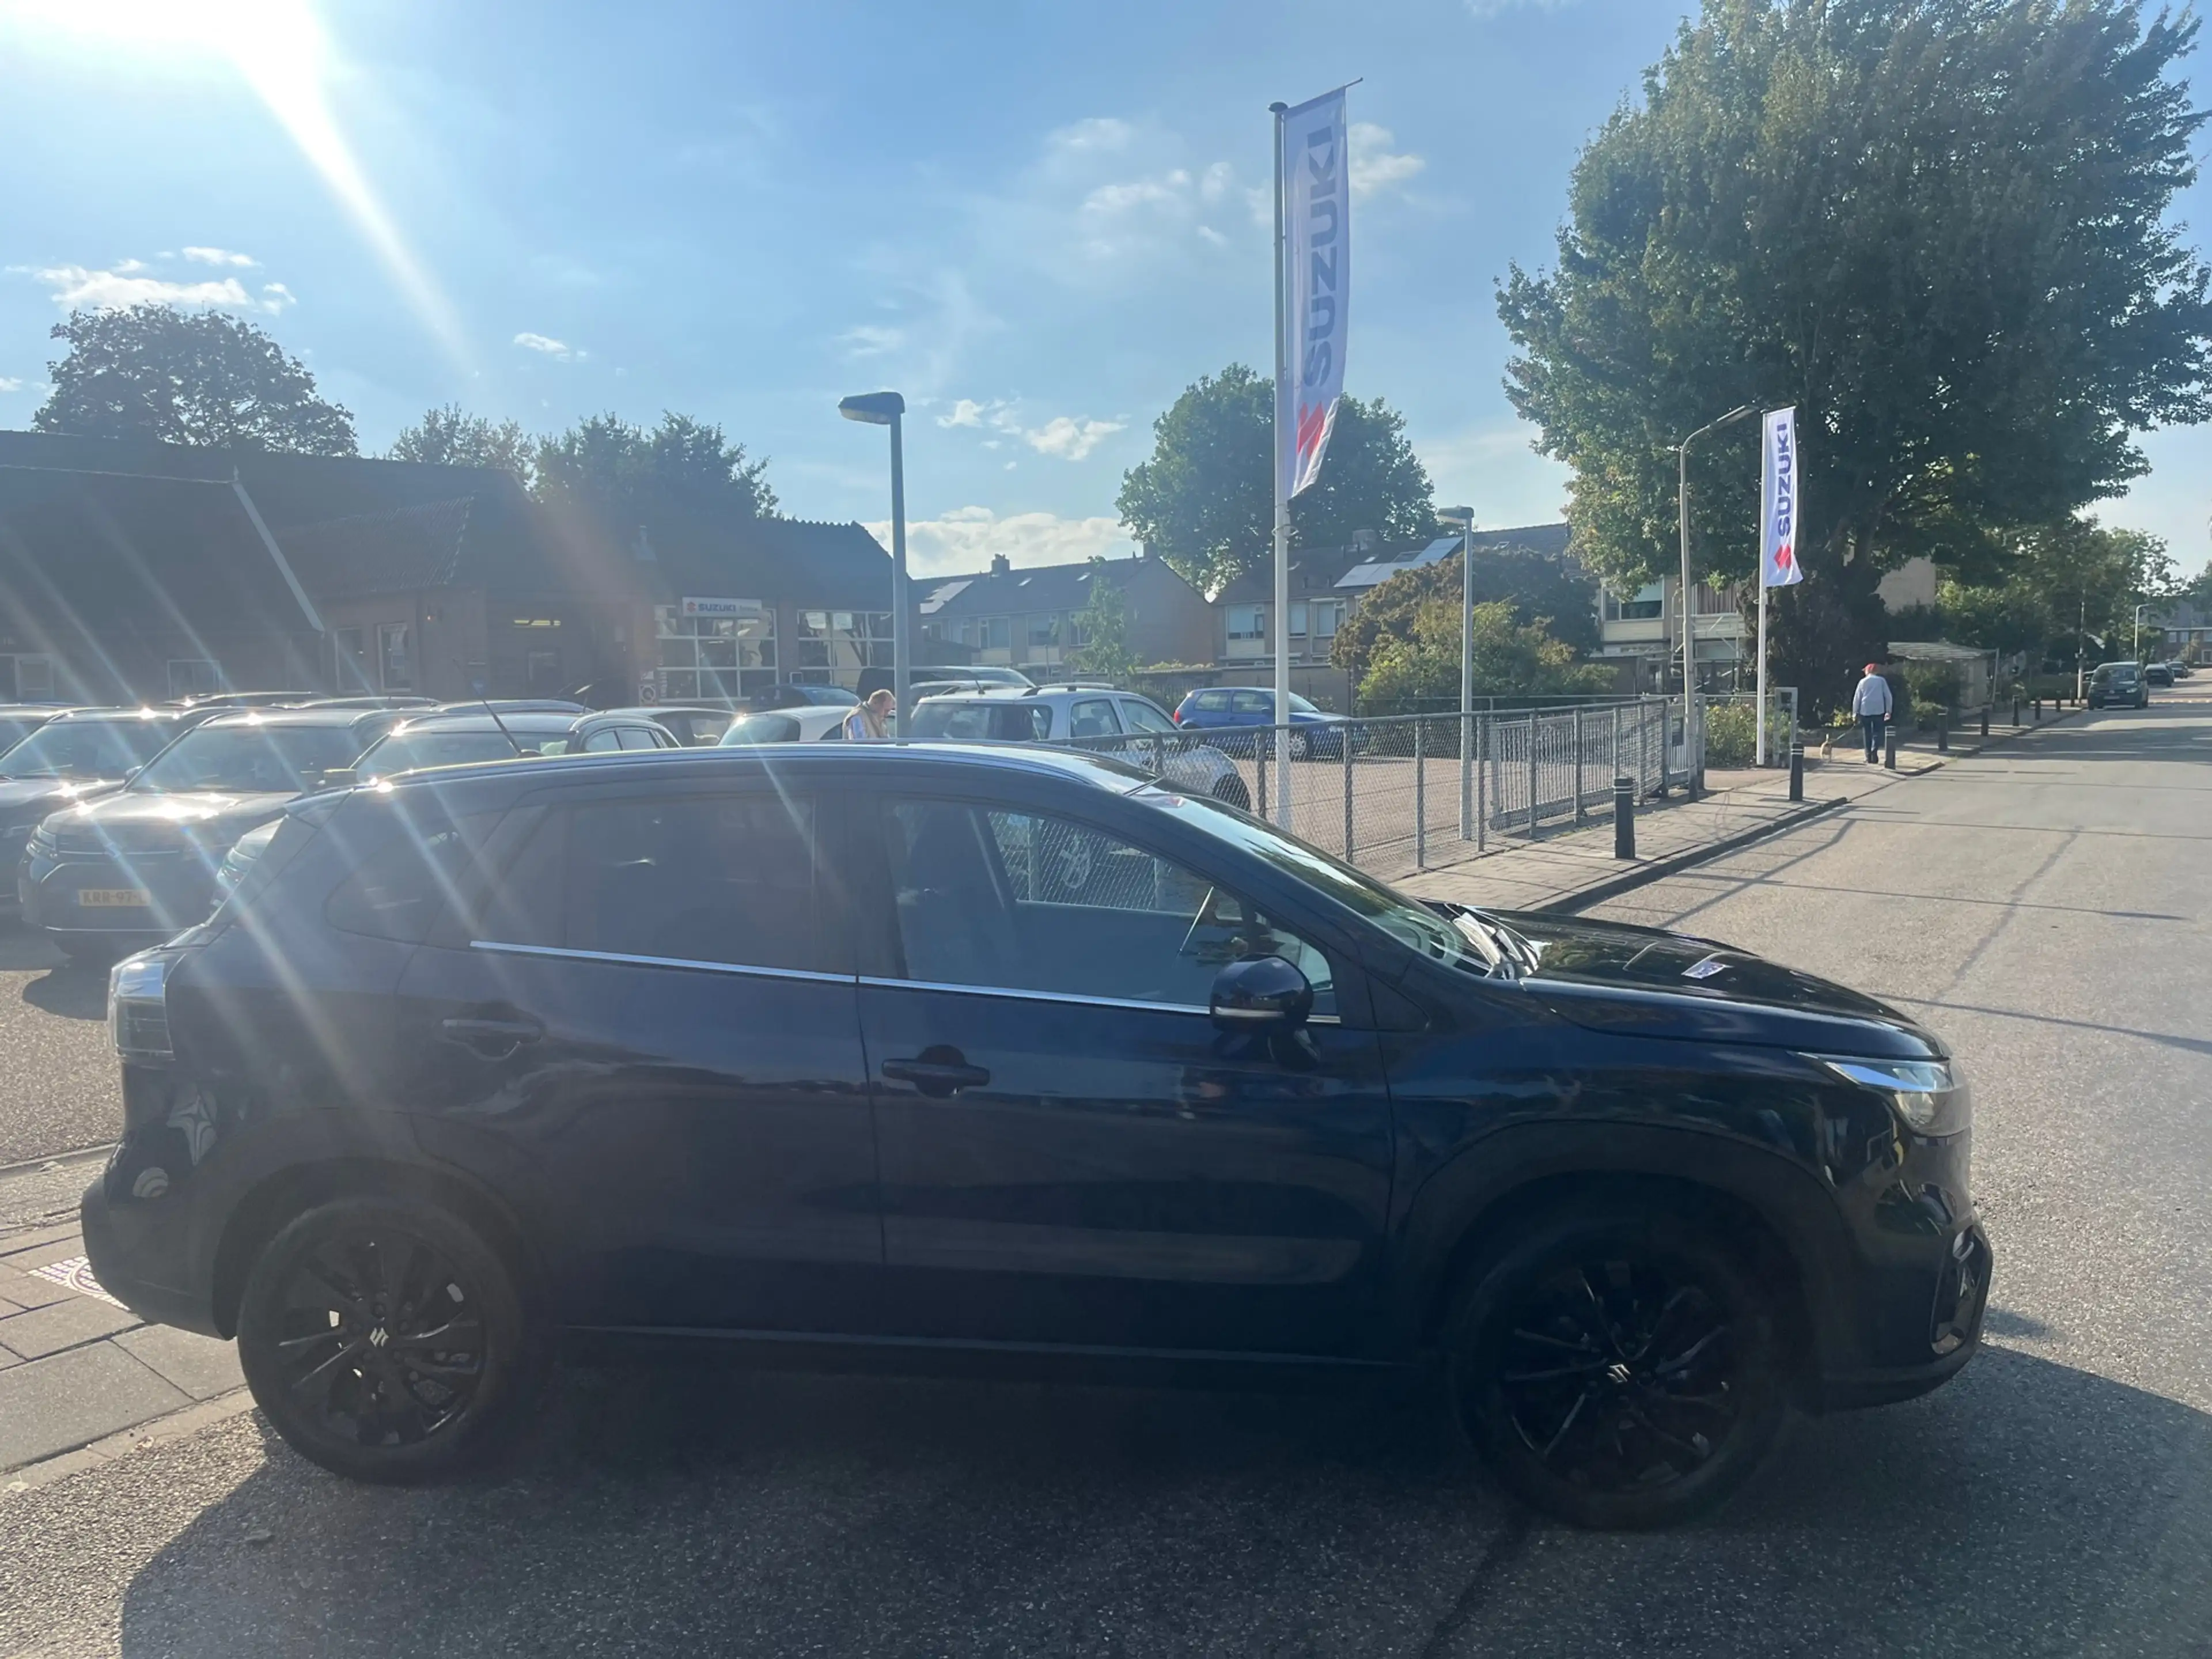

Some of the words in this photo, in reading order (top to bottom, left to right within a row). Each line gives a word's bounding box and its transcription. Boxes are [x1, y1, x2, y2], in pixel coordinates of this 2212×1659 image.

[1304, 126, 1338, 387] SUZUKI
[1777, 423, 1791, 537] SUZUKI
[698, 603, 736, 612] SUZUKI
